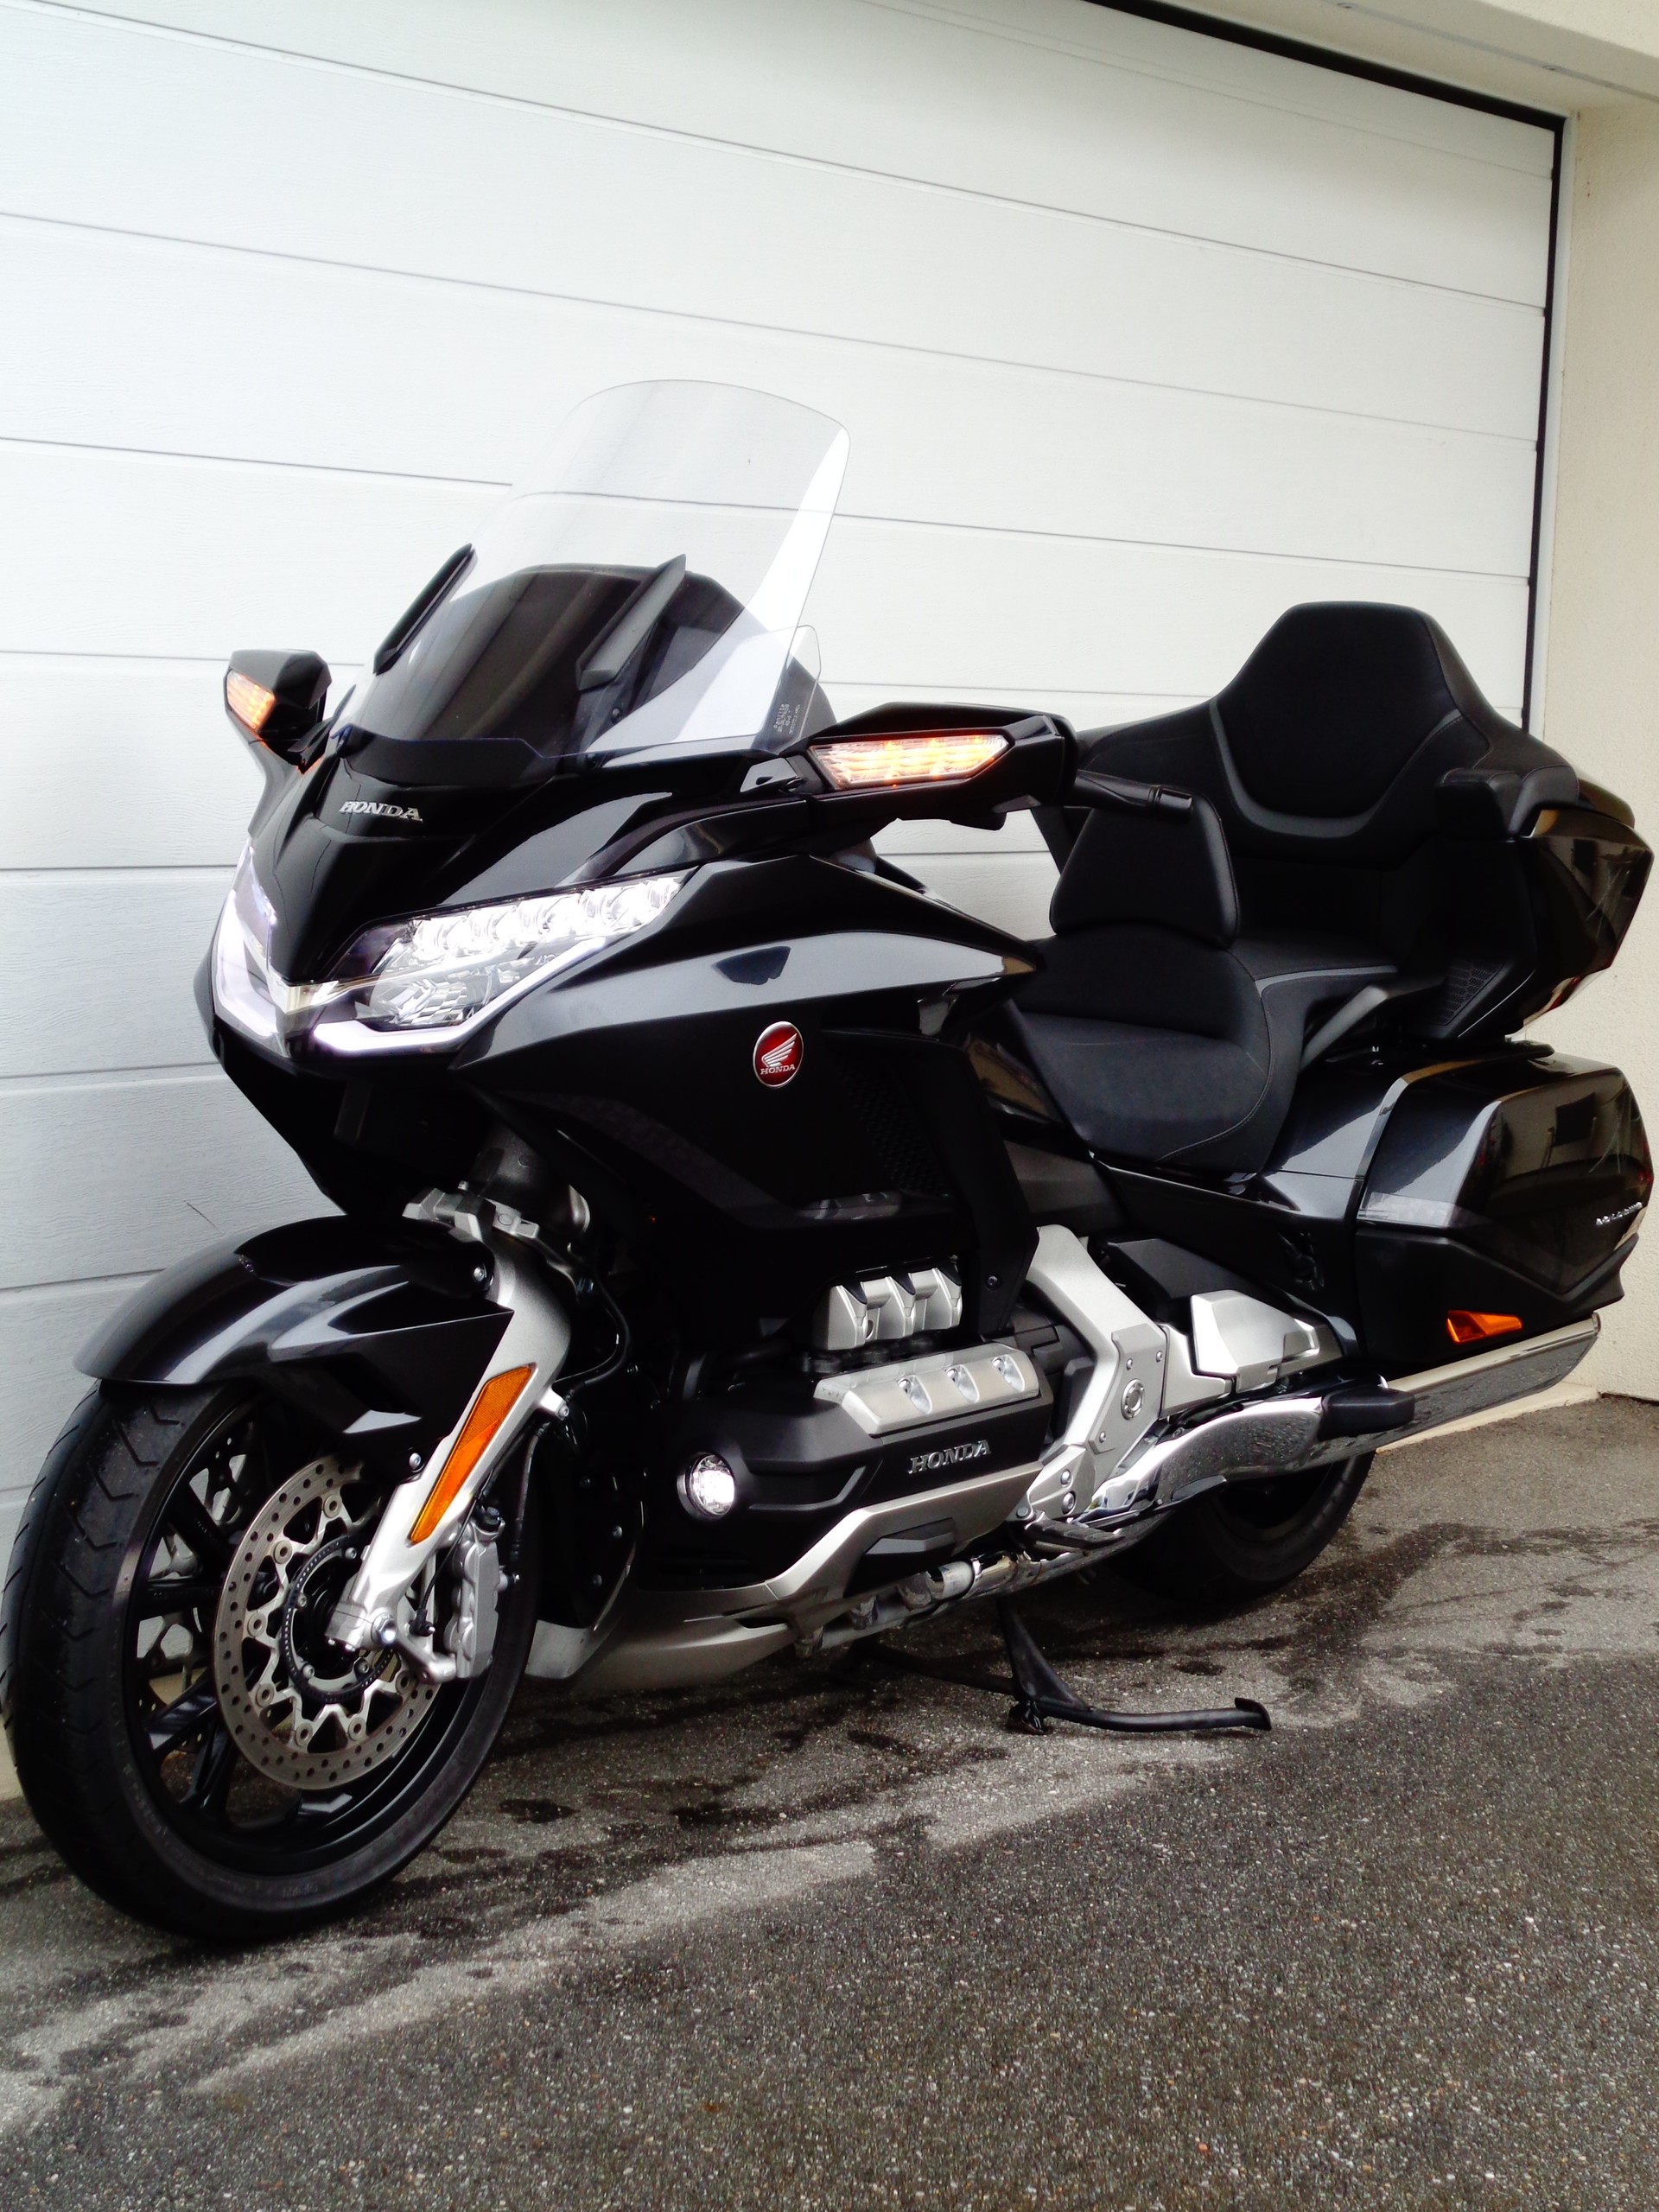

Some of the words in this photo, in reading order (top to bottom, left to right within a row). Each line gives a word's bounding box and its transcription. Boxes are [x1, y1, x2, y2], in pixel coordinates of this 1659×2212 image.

[339, 801, 423, 822] HONDA
[760, 1064, 796, 1075] HONDA
[908, 1440, 991, 1474] HONDA
